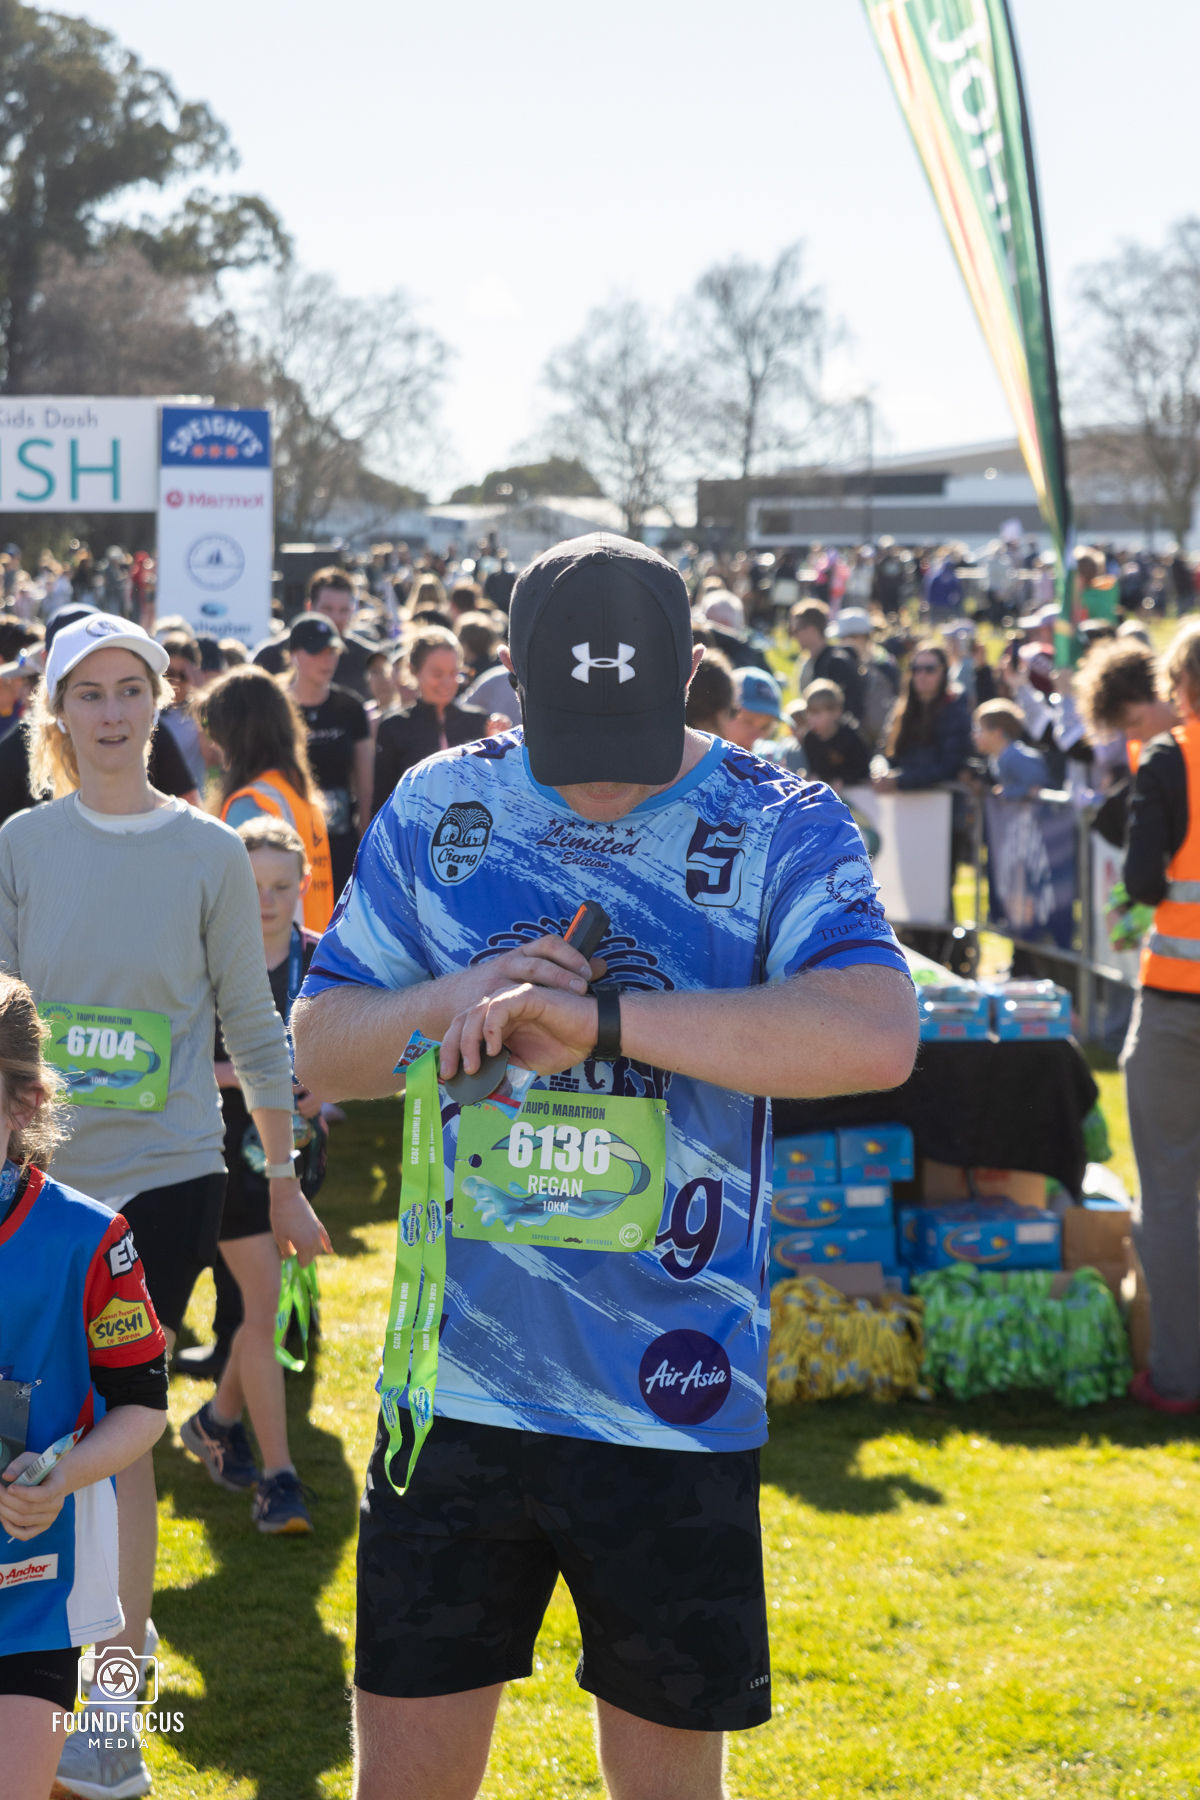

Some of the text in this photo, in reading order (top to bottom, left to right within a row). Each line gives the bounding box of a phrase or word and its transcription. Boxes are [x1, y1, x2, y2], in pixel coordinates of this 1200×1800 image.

[536, 824, 642, 857] Limited
[438, 848, 478, 867] Chang
[560, 850, 610, 870] Edition
[67, 1025, 136, 1062] 6704
[552, 1103, 606, 1121] MARATHON
[508, 1121, 611, 1175] 6136
[527, 1174, 584, 1198] REGAN
[542, 1200, 569, 1213] 10KM
[95, 1311, 143, 1340] SUSHI
[645, 1359, 727, 1396] AirAsia
[6, 1563, 48, 1580] Anchor
